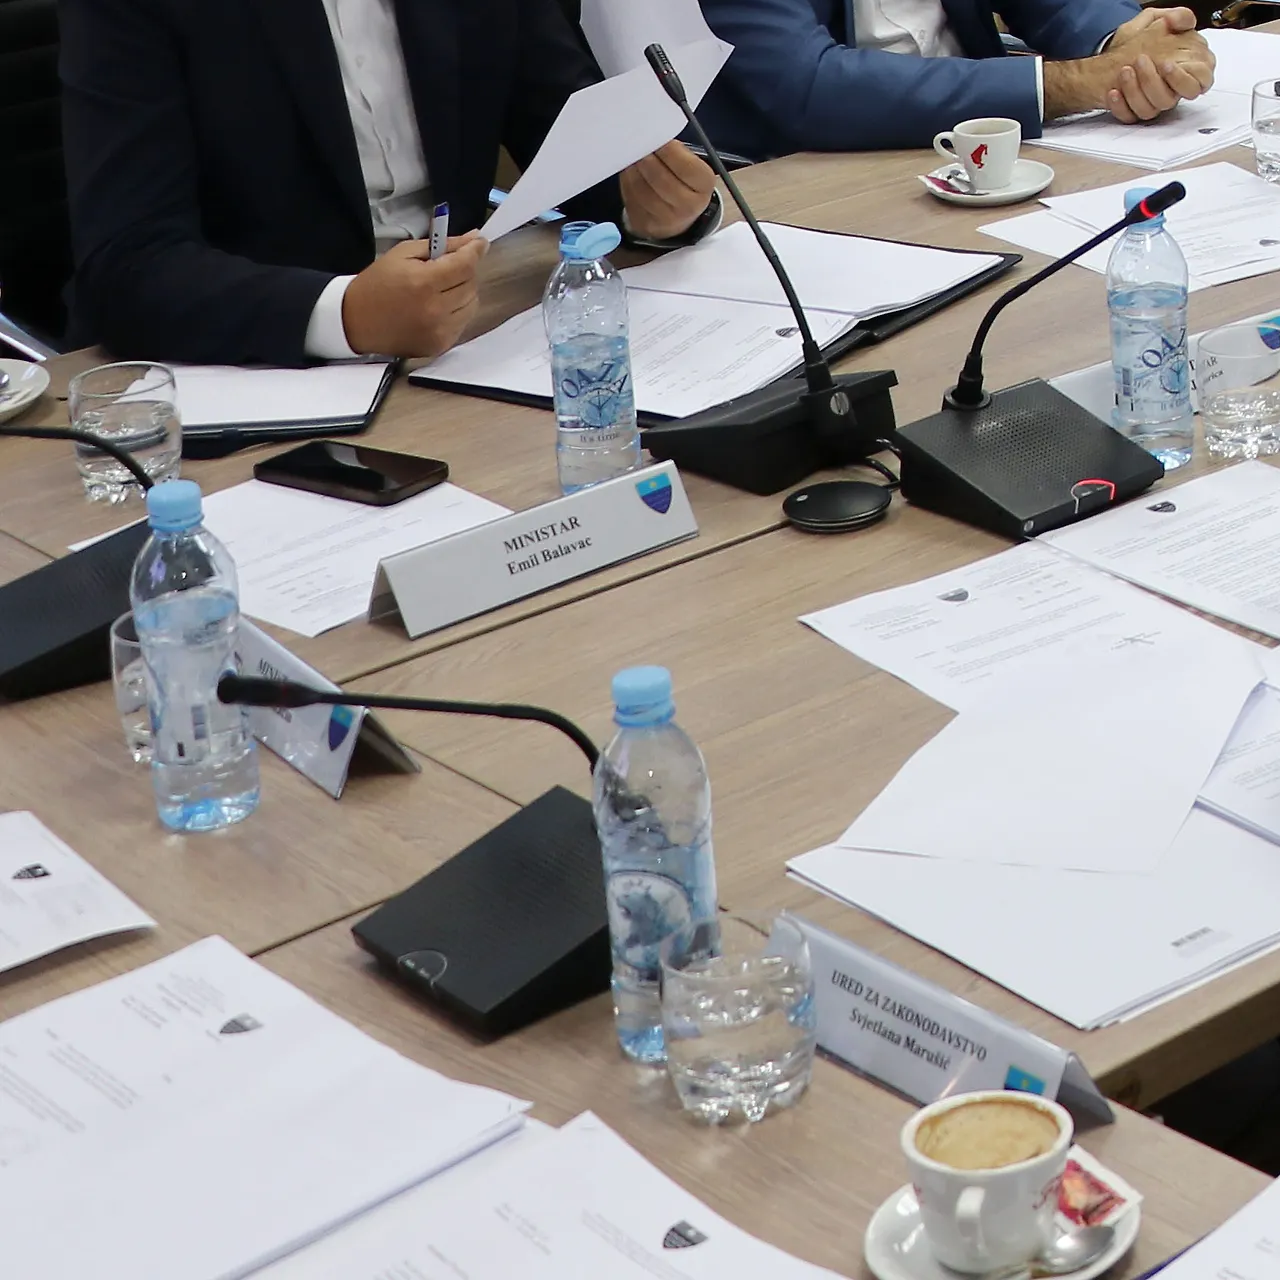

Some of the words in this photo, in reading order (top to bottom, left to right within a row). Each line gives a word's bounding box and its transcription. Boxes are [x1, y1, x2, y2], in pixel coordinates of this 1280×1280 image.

[561, 361, 628, 398] OAZA
[503, 516, 581, 554] MINISTAR
[507, 553, 541, 576] Emil
[541, 537, 592, 563] Balavac
[831, 969, 863, 996] URED
[864, 986, 879, 1007] ZA
[881, 996, 987, 1062] ZAKONODAVSTVO
[850, 1008, 901, 1047] Svjetlana
[901, 1035, 950, 1072] Marušić
